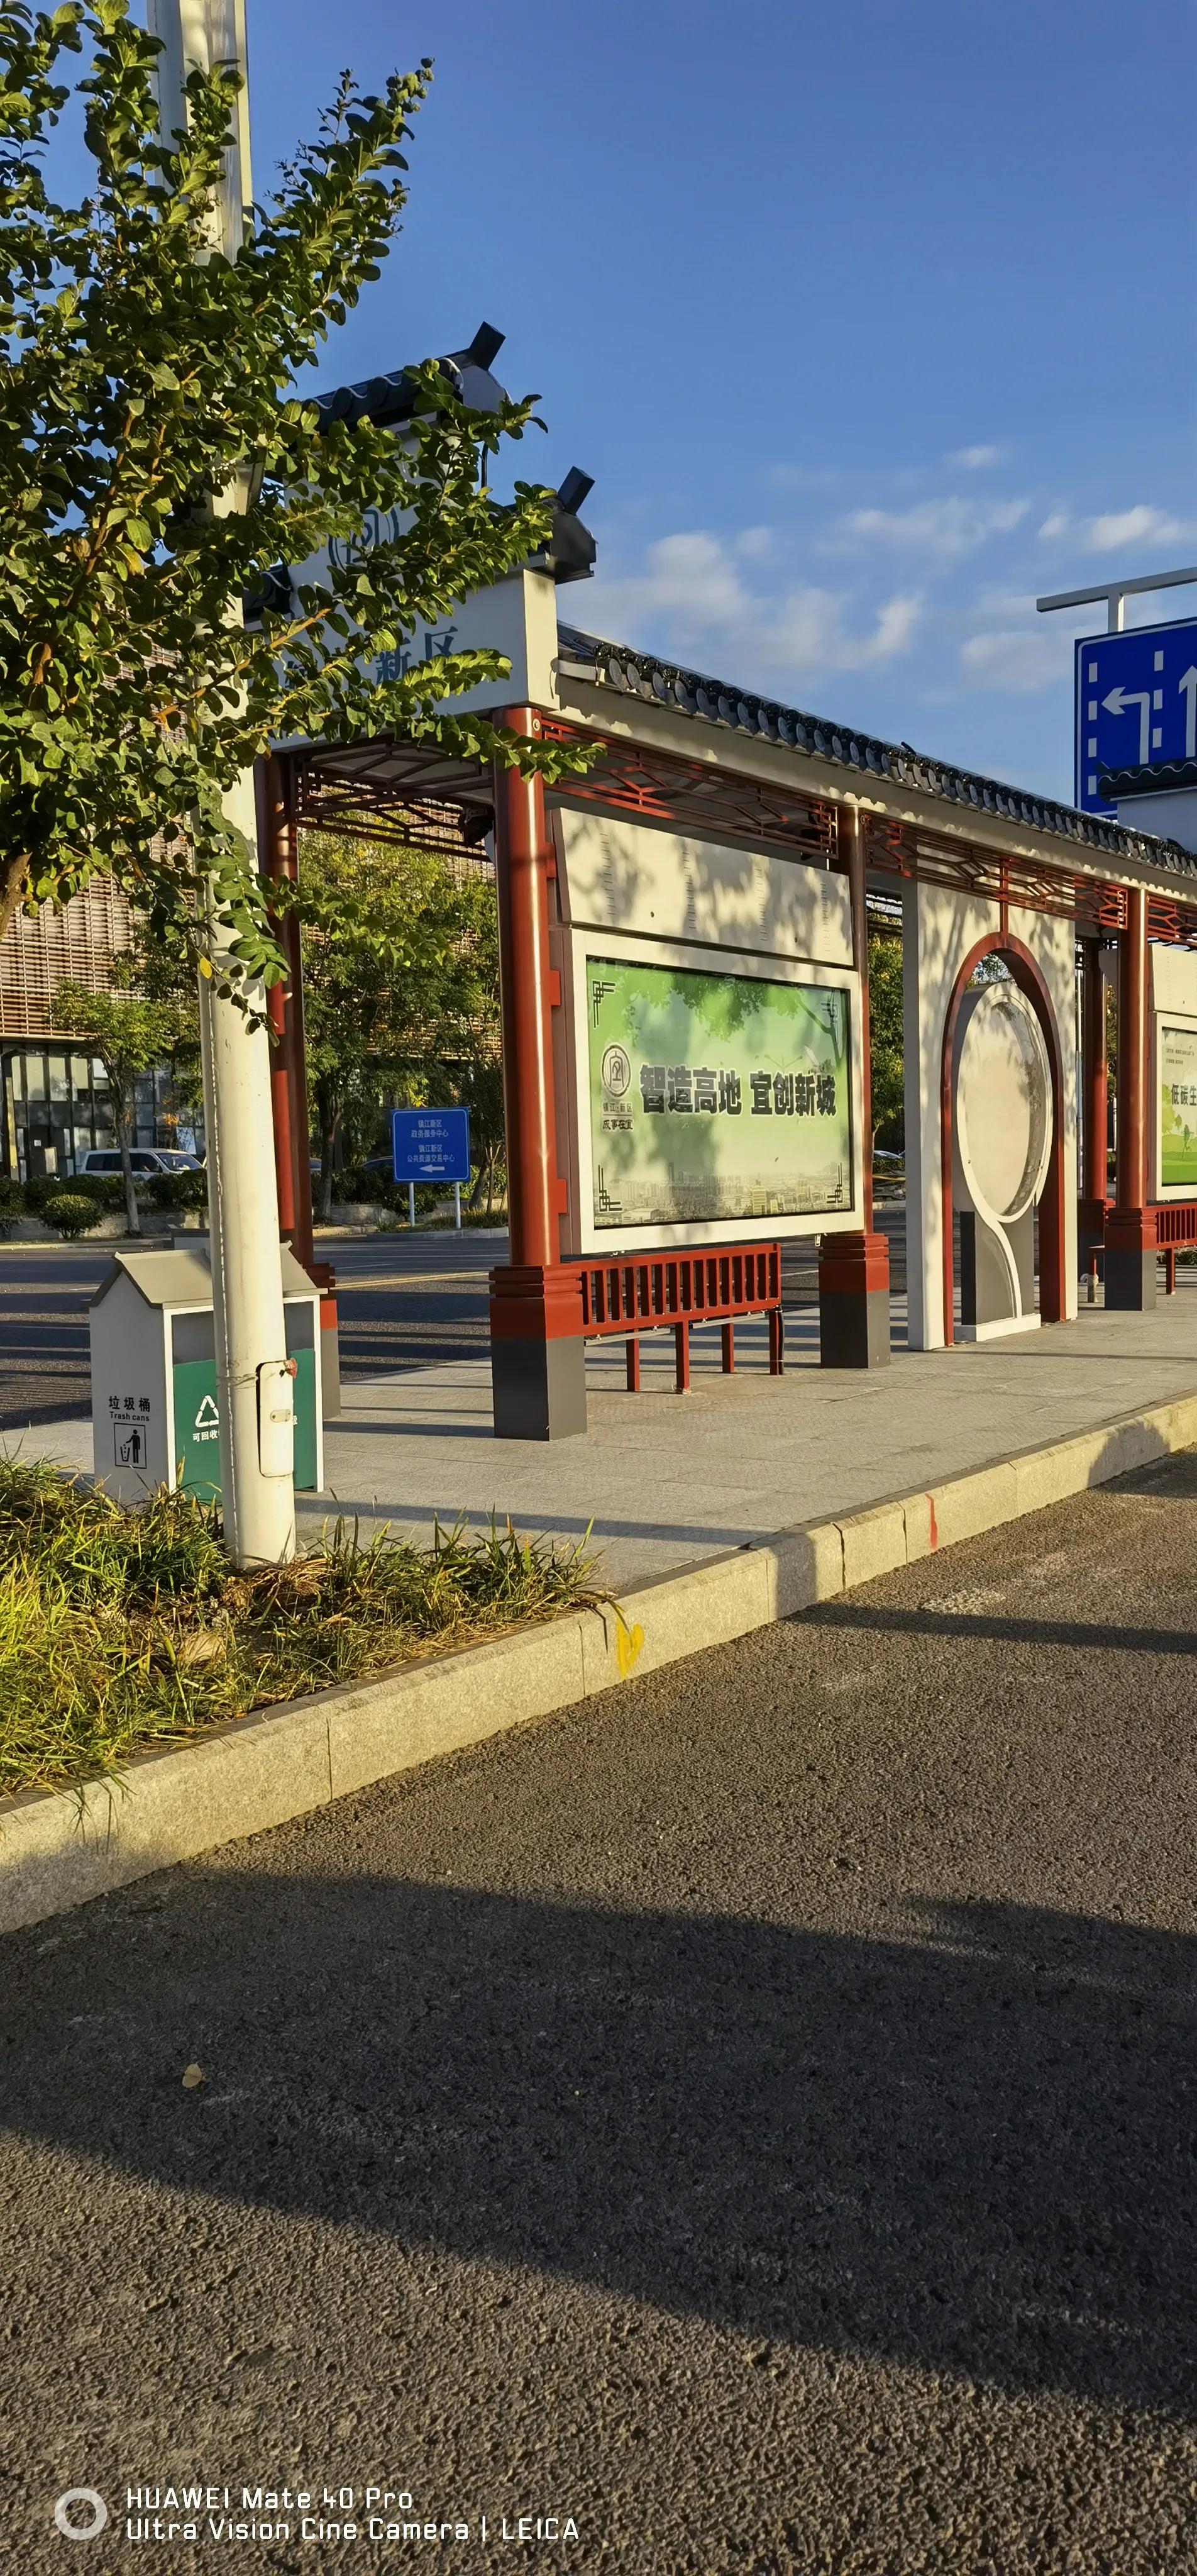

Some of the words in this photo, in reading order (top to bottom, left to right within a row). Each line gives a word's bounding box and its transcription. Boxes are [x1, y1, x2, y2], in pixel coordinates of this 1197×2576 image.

[640, 1064, 742, 1115] 智造高地
[750, 1070, 836, 1116] 宜创新城
[1171, 1084, 1197, 1106] 低碳生
[109, 1396, 150, 1413] 垃圾桶
[109, 1411, 131, 1420] Trash
[192, 1430, 220, 1442] 可回收
